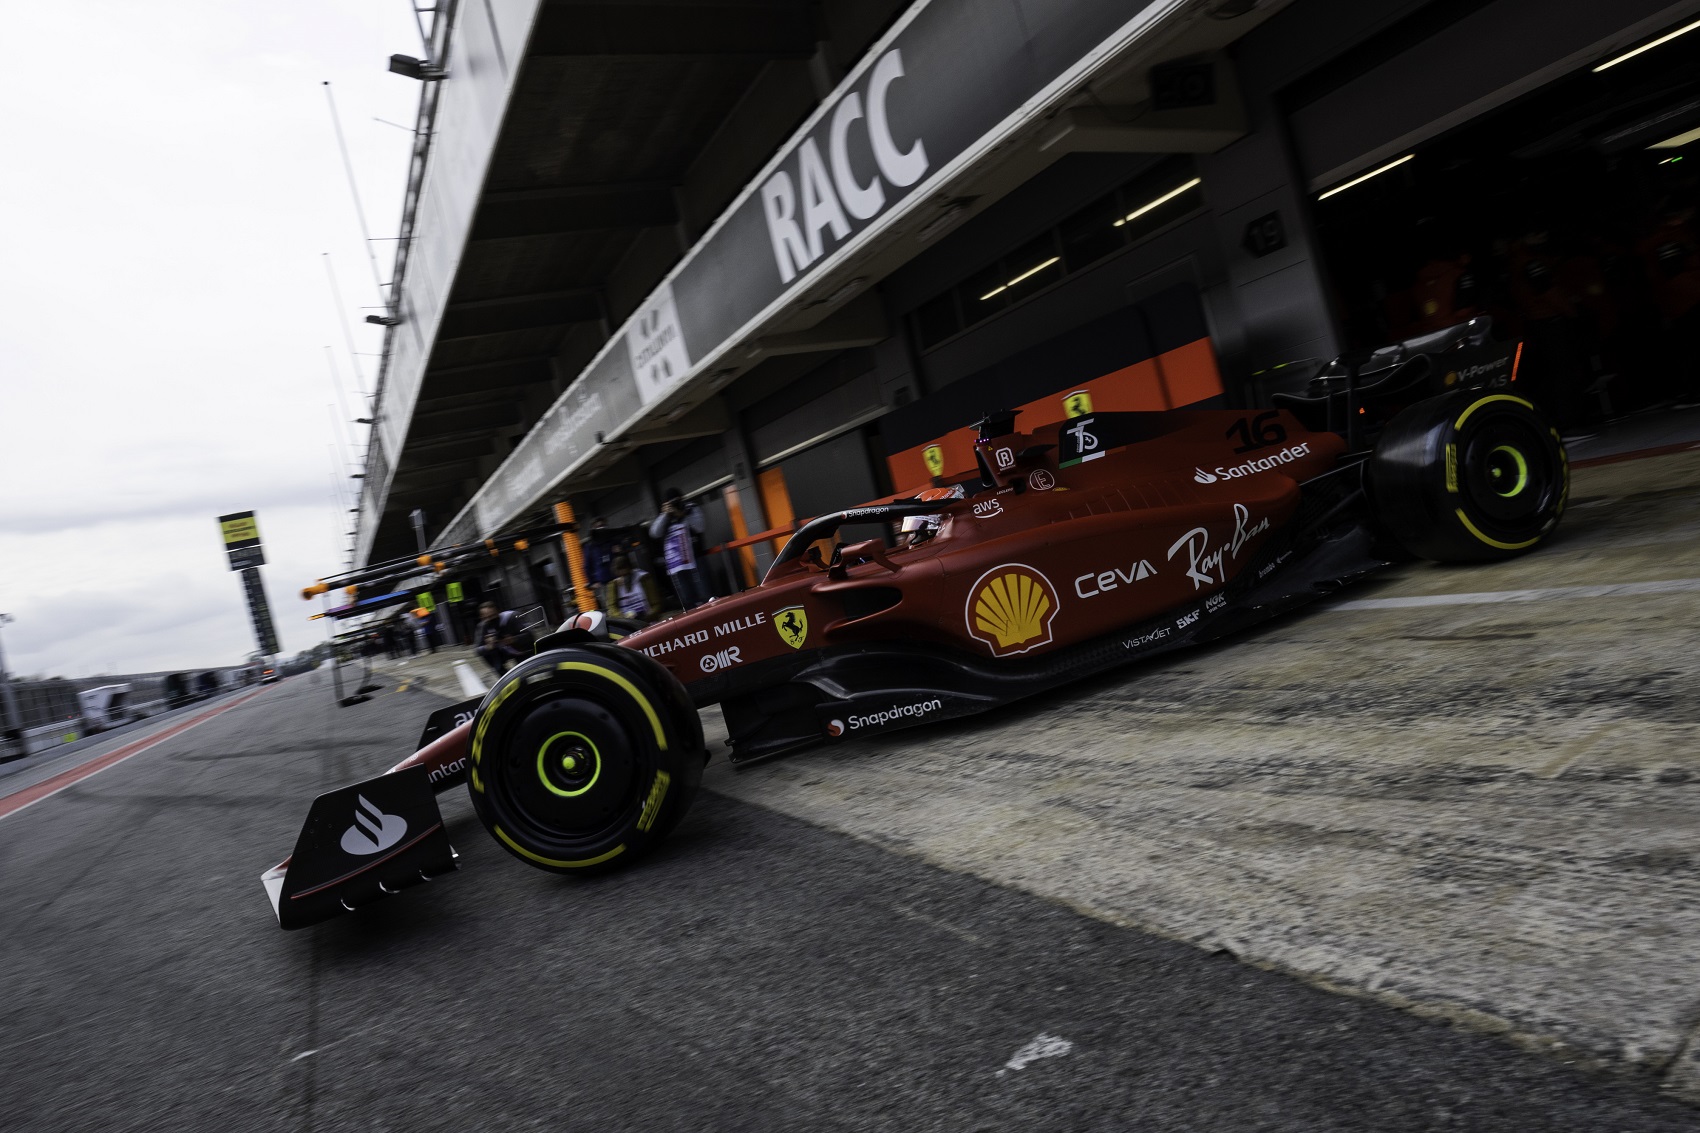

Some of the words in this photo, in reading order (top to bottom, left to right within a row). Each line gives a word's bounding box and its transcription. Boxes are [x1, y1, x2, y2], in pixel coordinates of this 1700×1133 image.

[760, 48, 930, 285] RACC
[1457, 356, 1509, 381] V-Power
[1226, 410, 1287, 454] 16
[1215, 442, 1311, 480] Santander
[848, 507, 889, 518] Snapdragon
[973, 498, 1000, 515] aws
[1205, 592, 1226, 609] NGK
[1176, 608, 1200, 629] SKF
[638, 629, 709, 658] ICHARD
[713, 611, 767, 638] MILLE
[848, 699, 942, 729] Snapdragon
